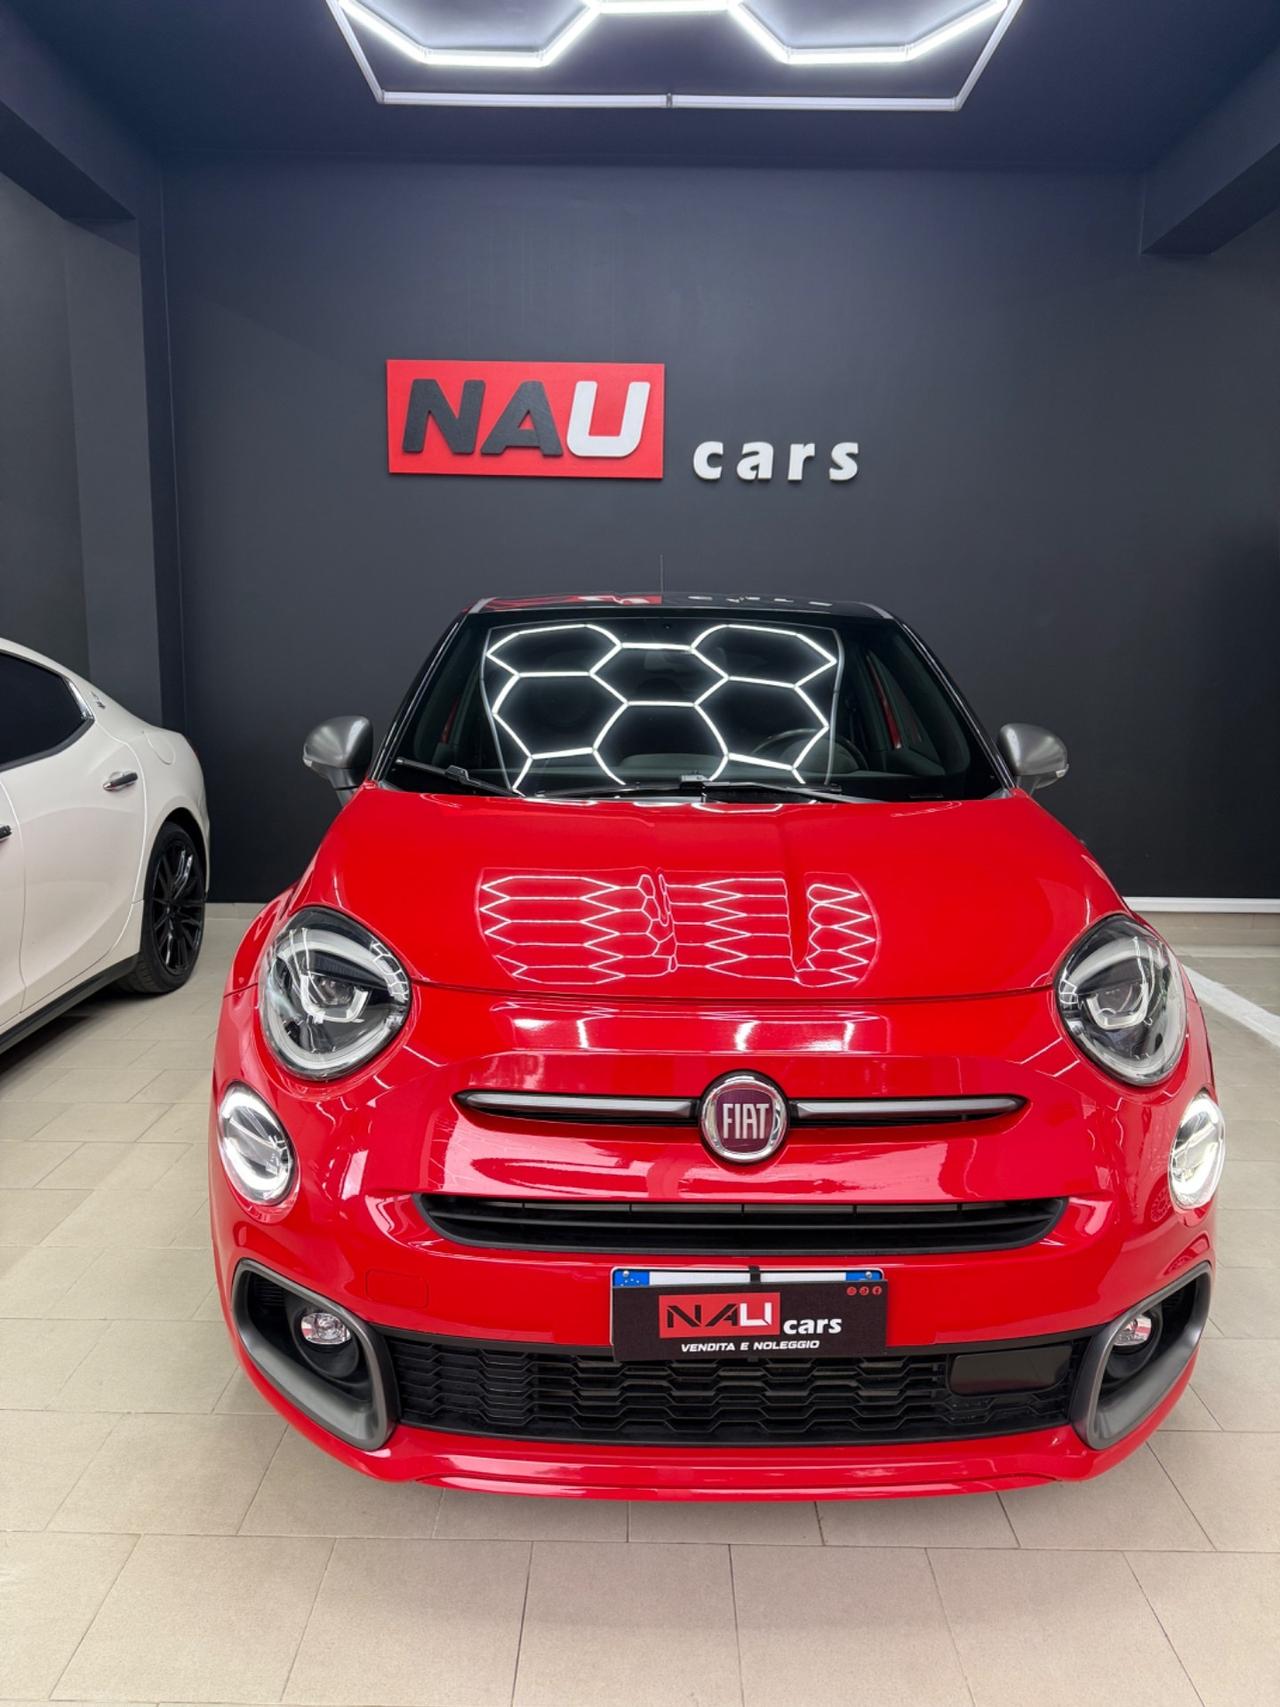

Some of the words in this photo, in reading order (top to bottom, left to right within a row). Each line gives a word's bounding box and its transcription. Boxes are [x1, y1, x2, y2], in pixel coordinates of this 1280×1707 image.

[402, 379, 651, 458] NAU
[693, 440, 859, 481] cars
[722, 1103, 770, 1139] FIAT
[666, 1302, 772, 1328] NAU
[783, 1318, 842, 1334] cars
[681, 1342, 735, 1352] VENDITA
[740, 1342, 749, 1351] E
[753, 1340, 820, 1350] NOLEGGIO
